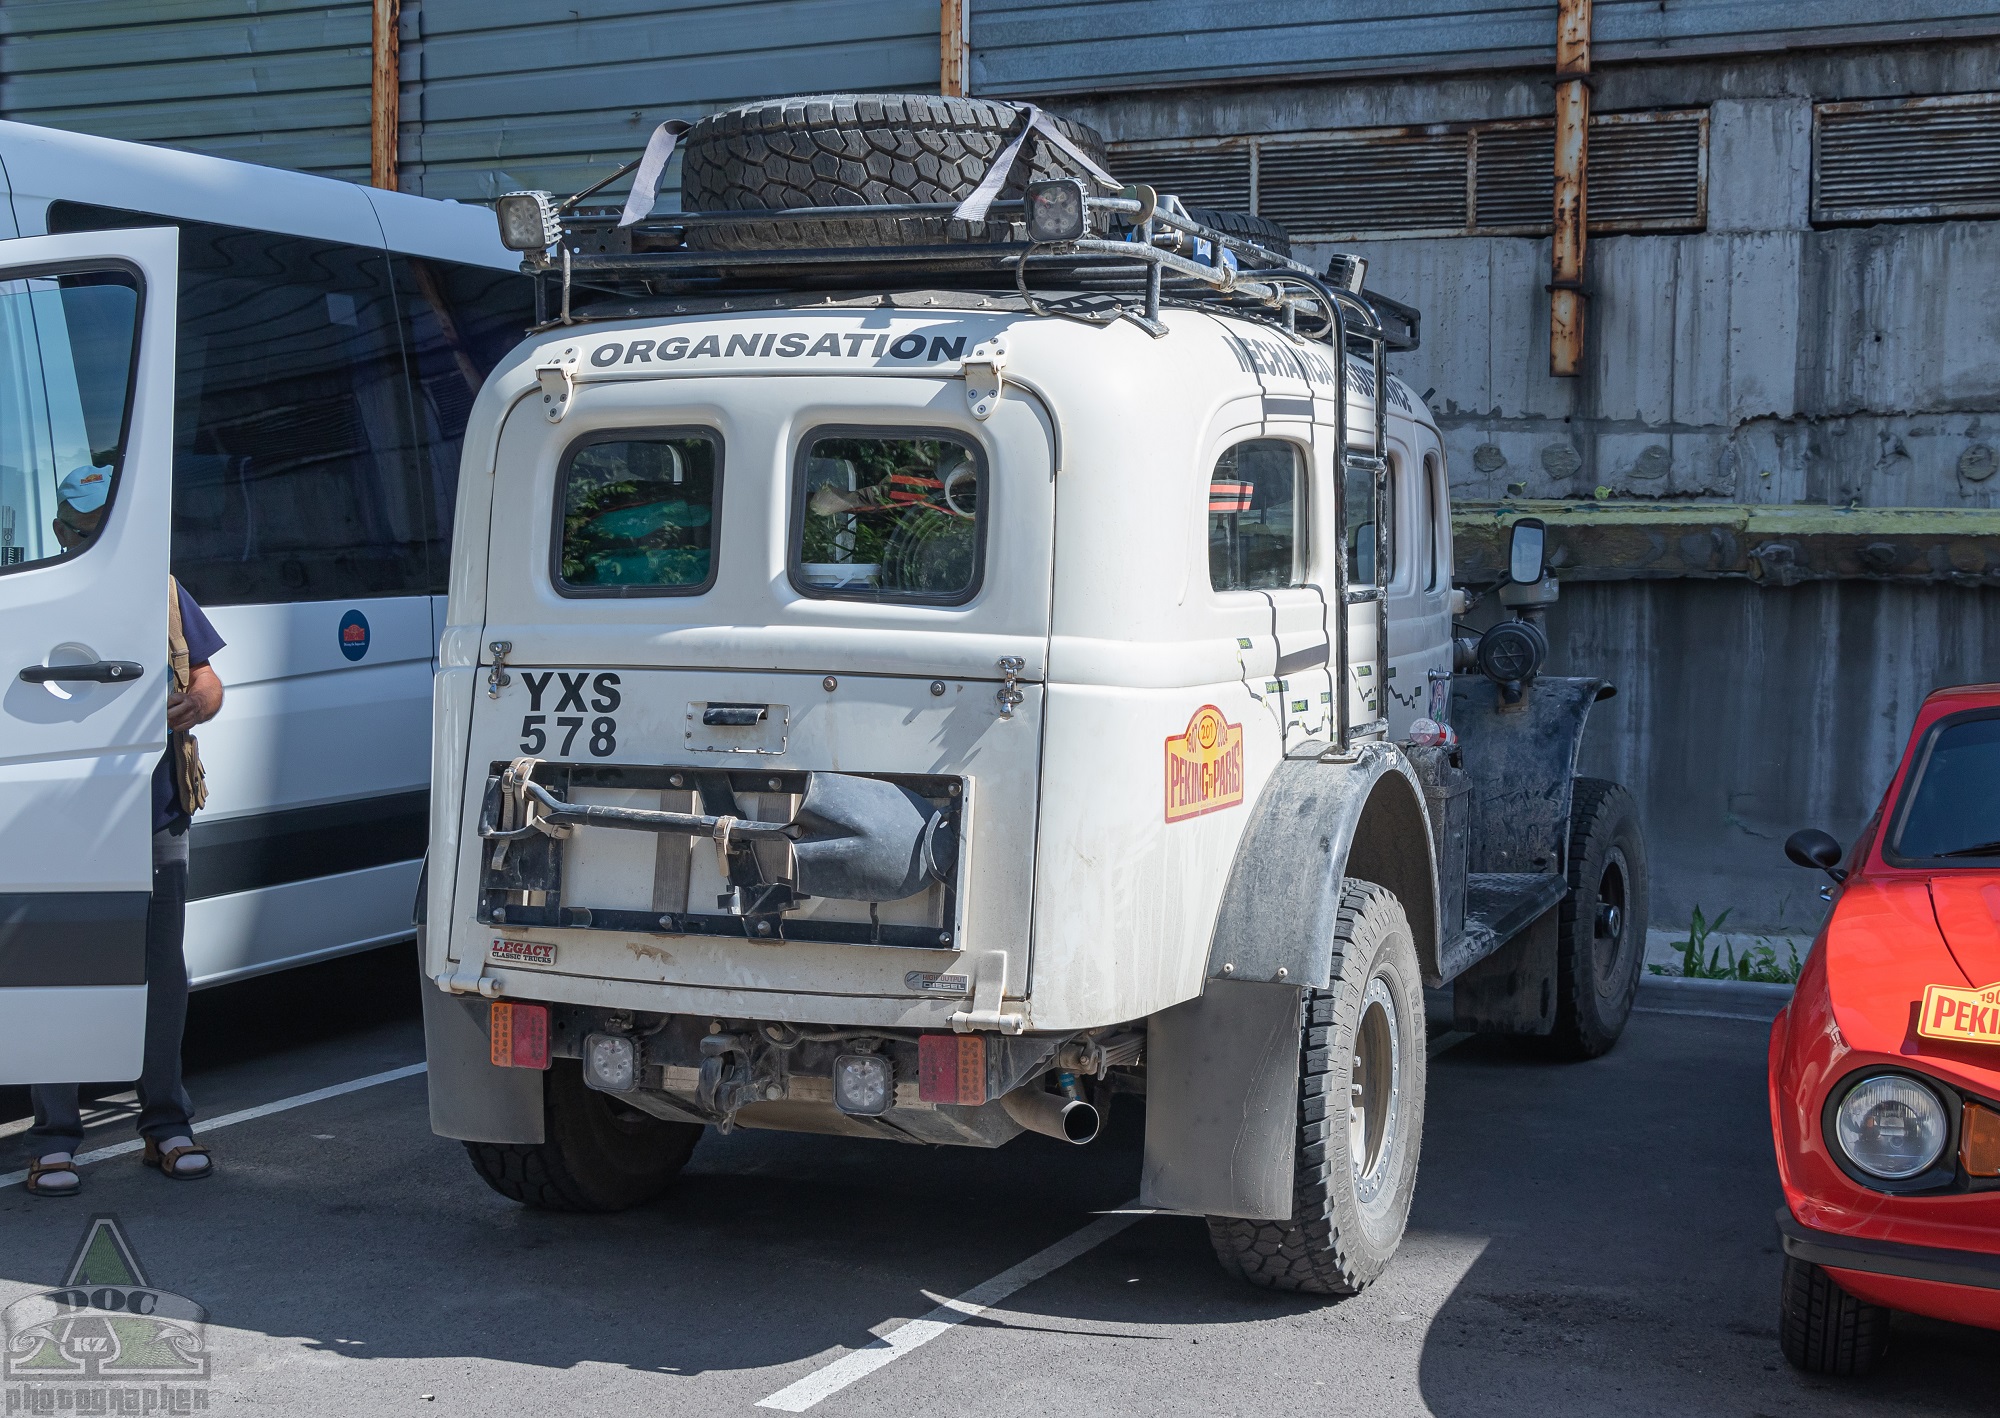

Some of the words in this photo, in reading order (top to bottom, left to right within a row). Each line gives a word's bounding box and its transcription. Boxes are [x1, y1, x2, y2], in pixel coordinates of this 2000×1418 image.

[590, 333, 966, 368] ORGANISATION
[520, 672, 621, 713] YXS
[519, 715, 617, 757] 578
[1201, 722, 1213, 740] 201
[1170, 752, 1209, 809] PEKING
[1213, 739, 1241, 799] PARIS
[492, 952, 521, 960] CLASSIC
[523, 955, 551, 963] TRUCKS
[493, 941, 553, 957] LEGACY
[923, 982, 966, 990] DIESEL
[1933, 995, 2000, 1034] PEKI
